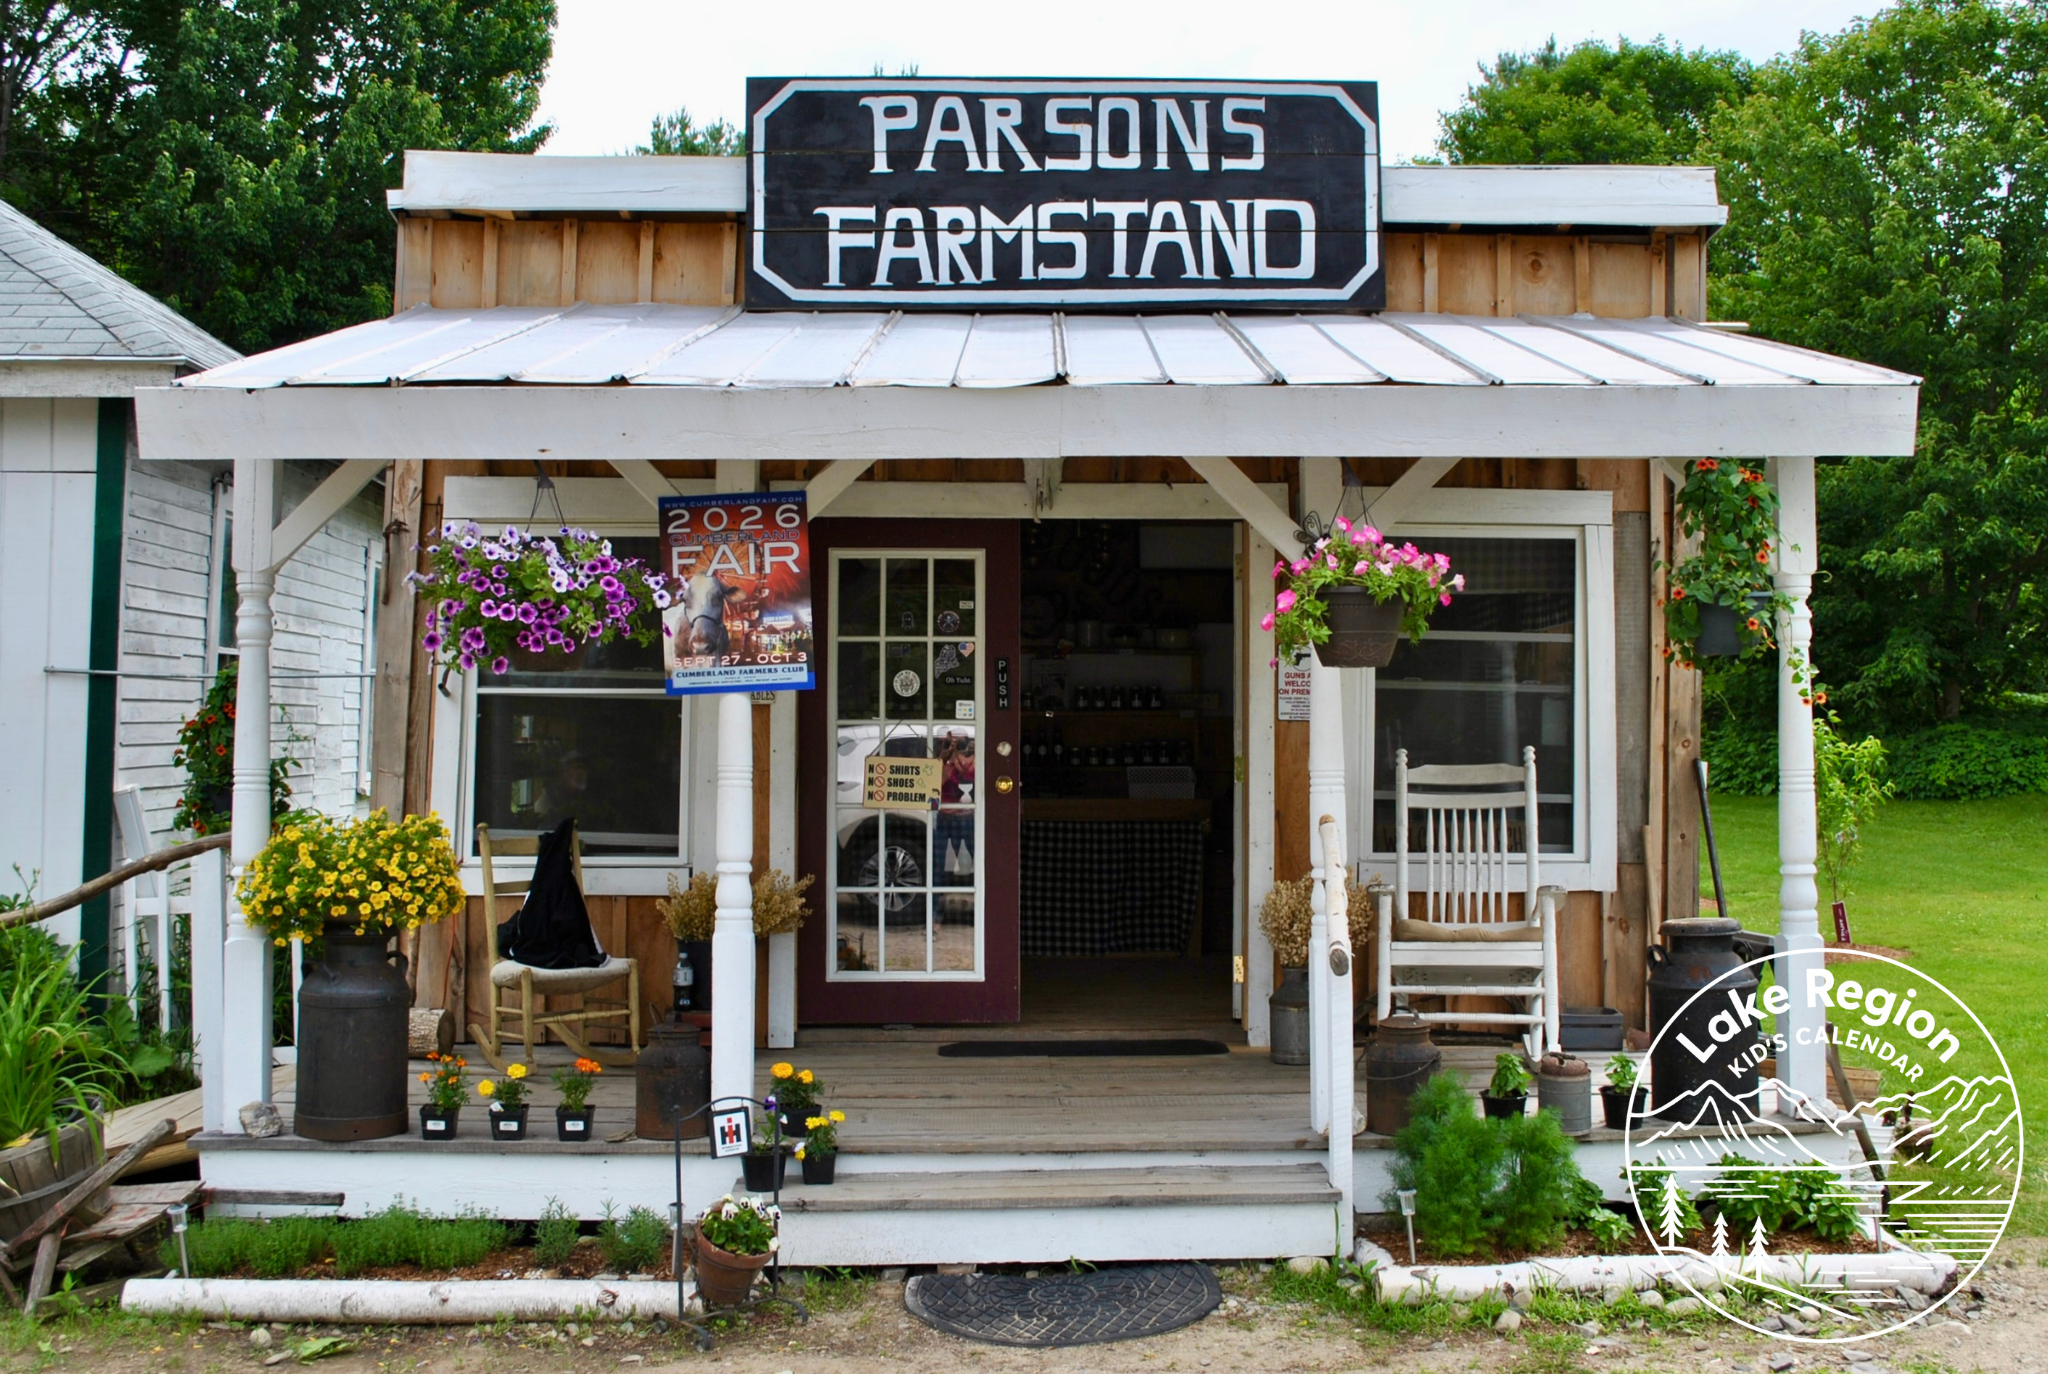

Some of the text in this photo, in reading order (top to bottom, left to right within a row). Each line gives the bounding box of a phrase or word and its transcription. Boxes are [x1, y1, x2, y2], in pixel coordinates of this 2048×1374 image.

[859, 95, 1266, 173] PARSONS
[813, 198, 1317, 286] FARMSTAND
[667, 504, 800, 534] 2026
[669, 529, 800, 546] CUMBERLAND
[672, 541, 801, 578] FAIR
[672, 656, 715, 668] SEPT
[721, 655, 740, 666] 27
[757, 653, 792, 664] OCT
[797, 652, 807, 662] 3
[676, 669, 735, 678] CUMBERLAND
[739, 667, 778, 675] FARMERS
[998, 660, 1008, 707] PUSH
[889, 765, 920, 775] SHIRTS
[887, 777, 914, 788] SHOES
[887, 791, 926, 802] PROBLEM
